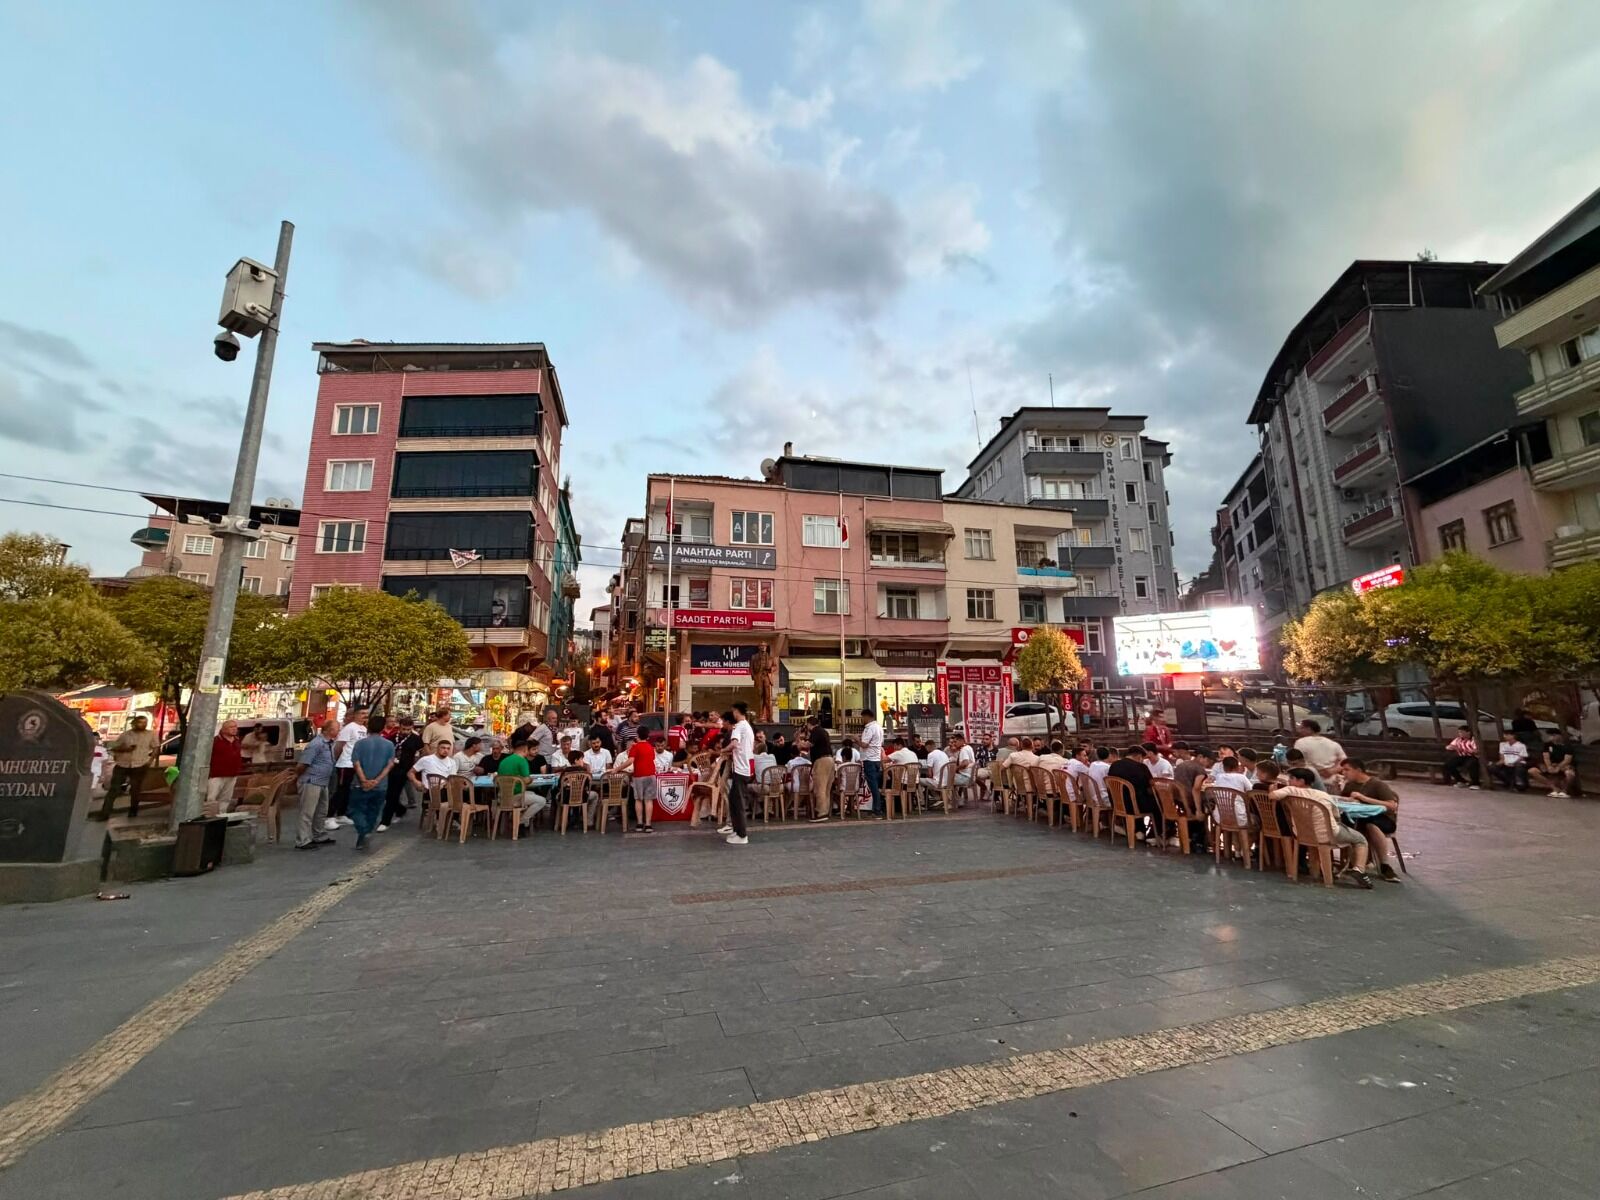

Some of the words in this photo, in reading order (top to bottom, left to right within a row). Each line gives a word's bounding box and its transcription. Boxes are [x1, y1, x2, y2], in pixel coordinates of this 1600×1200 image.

[1105, 451, 1116, 490] ORMAN
[675, 546, 722, 557] ANAHTAR
[675, 614, 712, 625] SAADET
[713, 615, 748, 625] PARTİSİ
[699, 660, 722, 668] YÜKSEL
